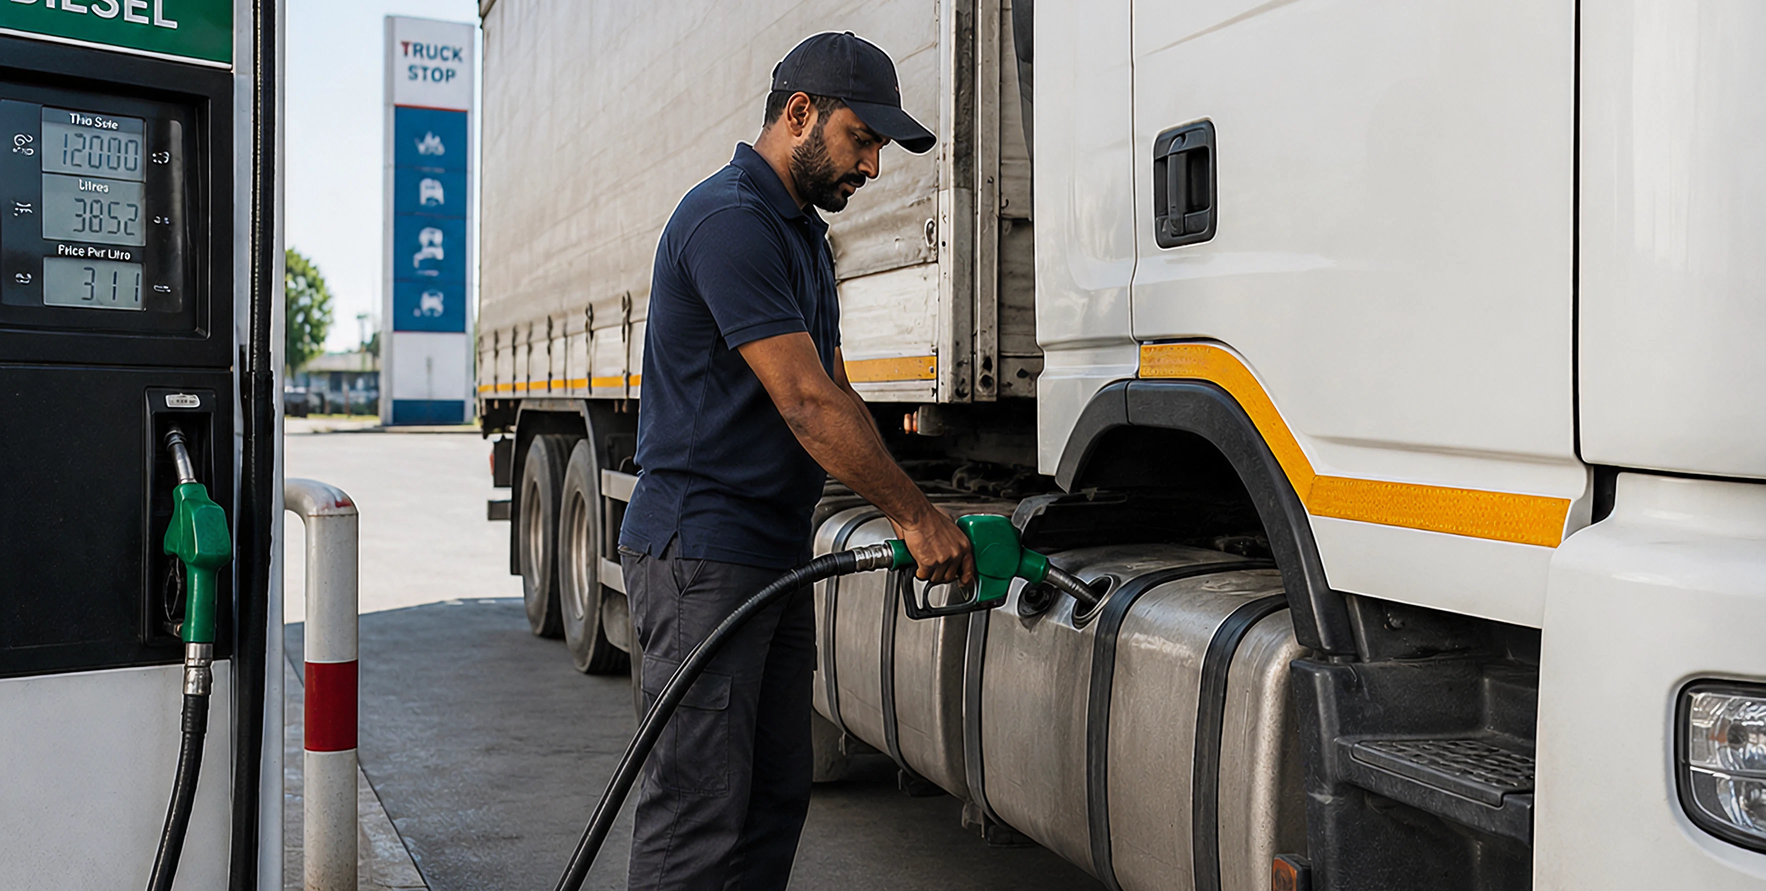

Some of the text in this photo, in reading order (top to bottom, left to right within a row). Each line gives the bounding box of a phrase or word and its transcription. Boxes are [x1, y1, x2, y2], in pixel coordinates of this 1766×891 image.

[10, 0, 178, 29] SEL
[401, 41, 463, 63] TRUCK
[408, 64, 456, 83] STOP
[63, 133, 138, 171] 12000
[73, 198, 138, 236] 3852
[58, 244, 85, 257] Price
